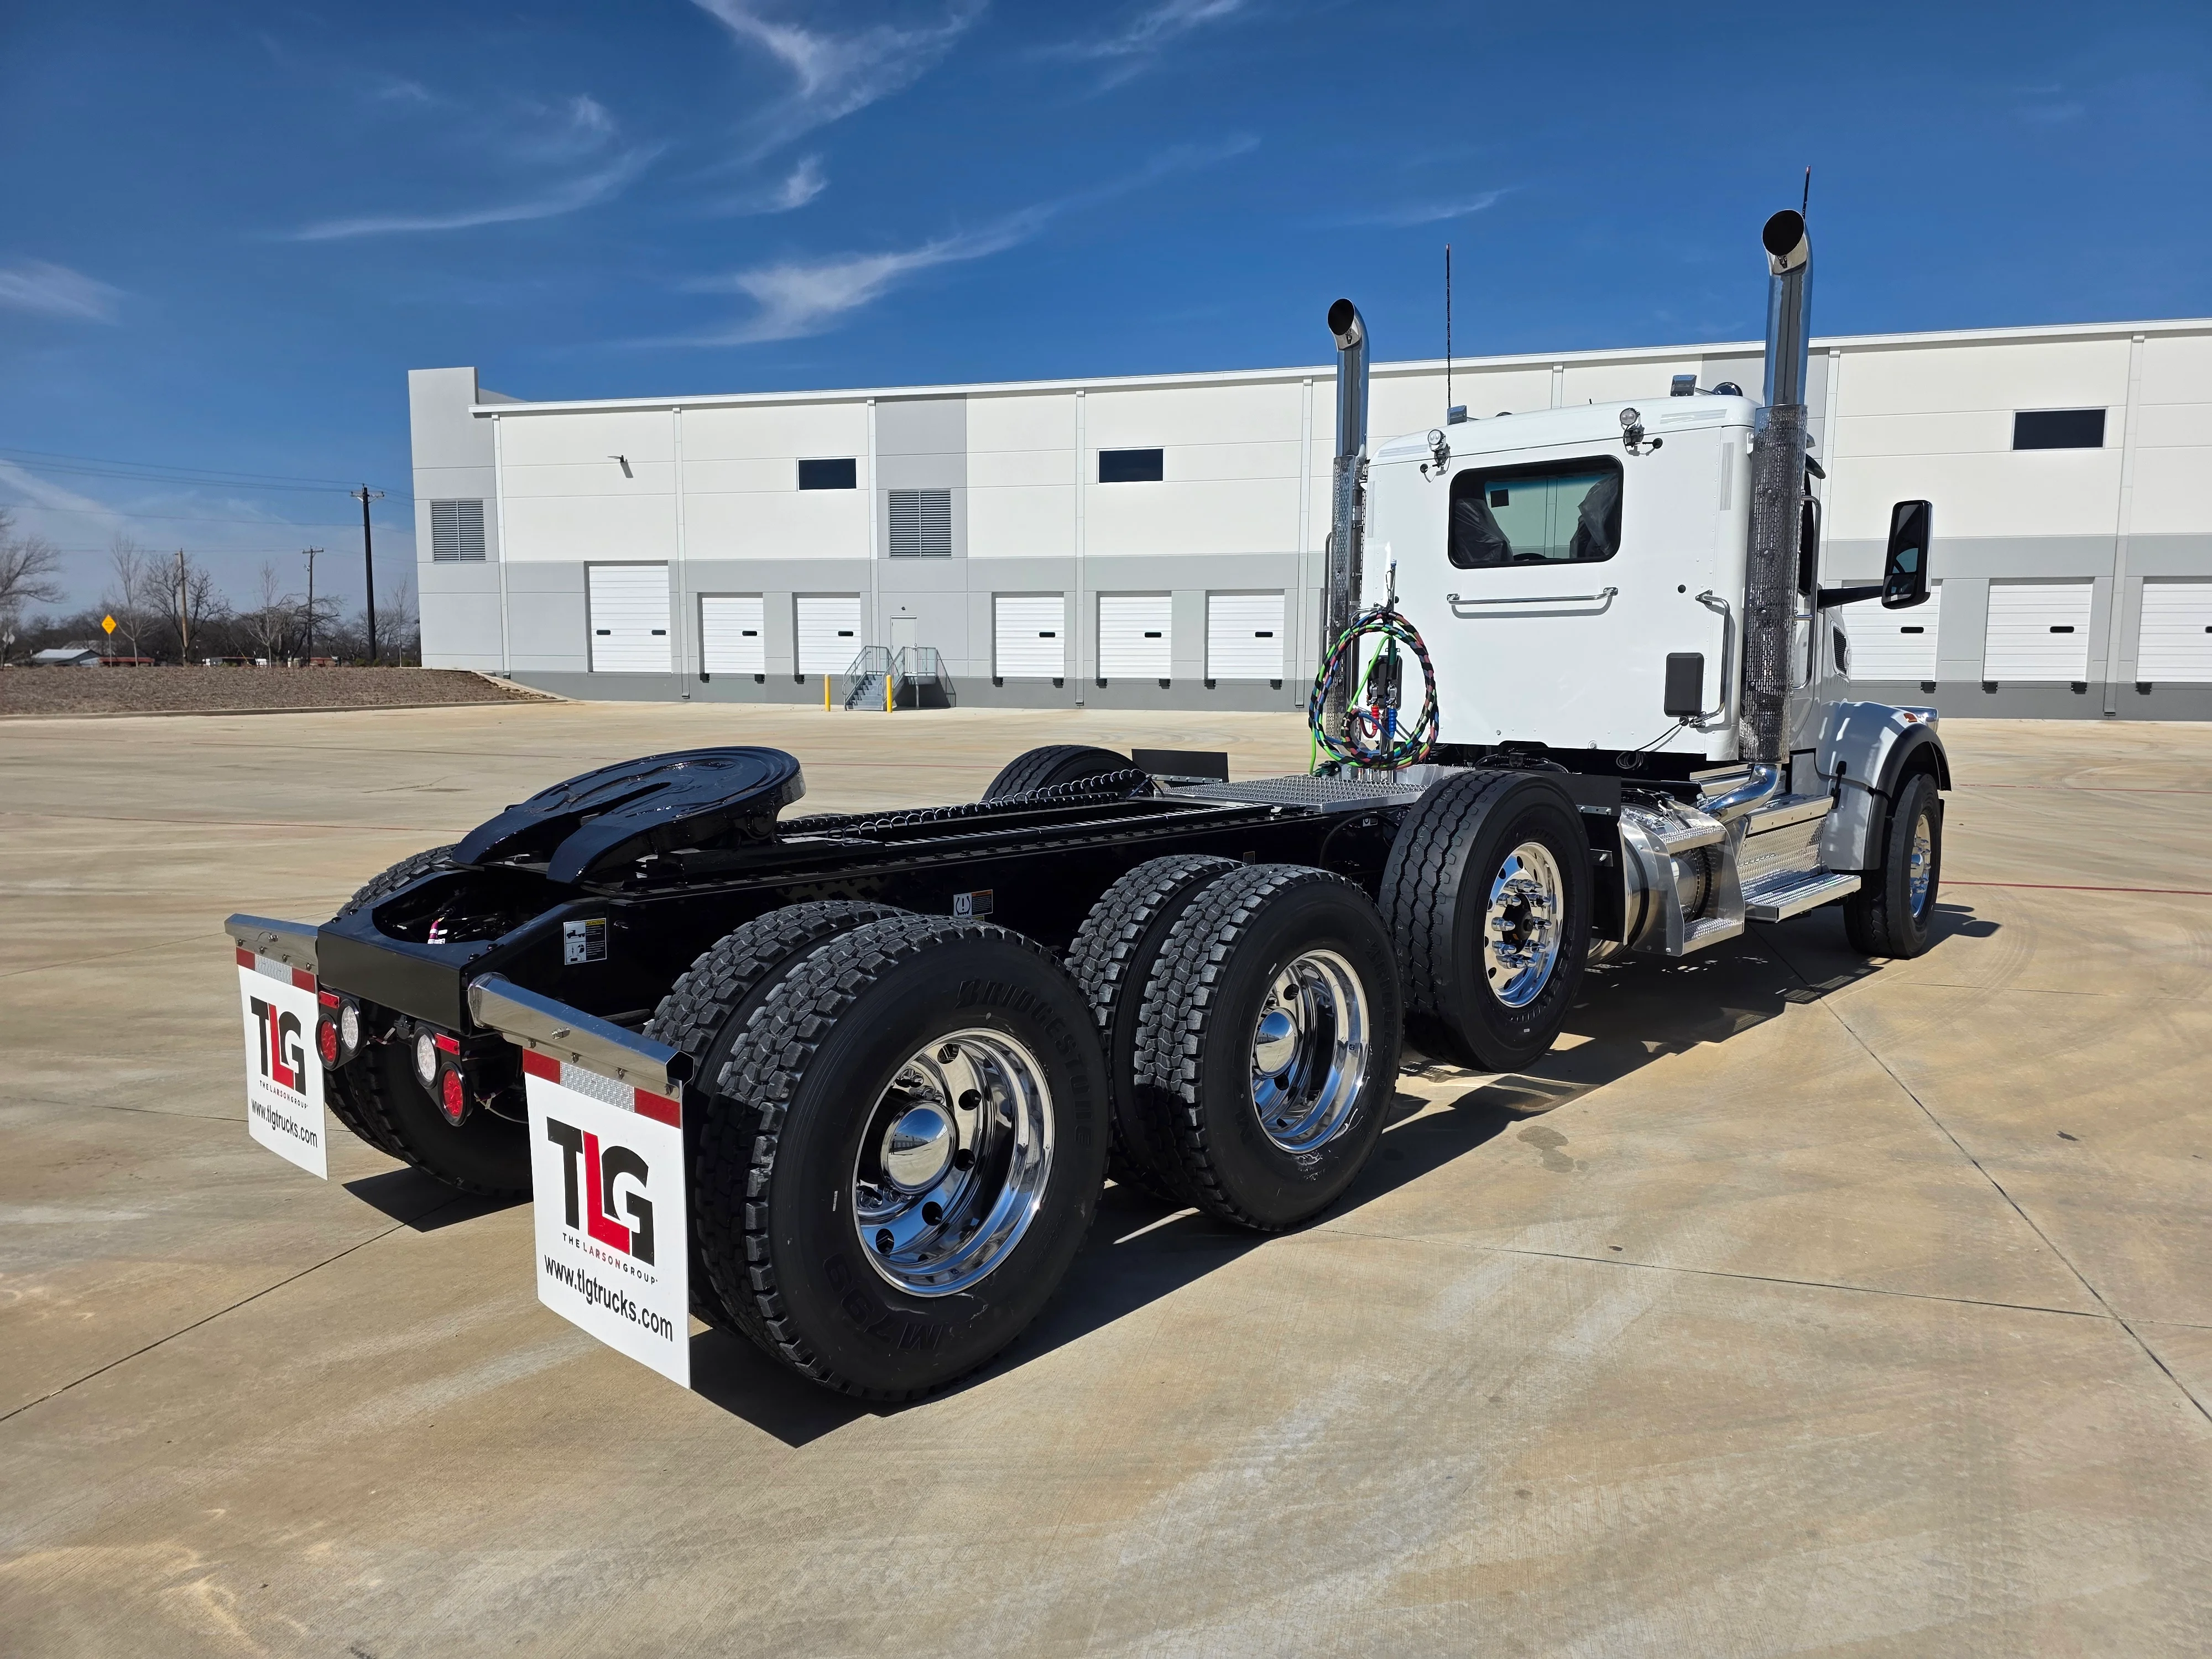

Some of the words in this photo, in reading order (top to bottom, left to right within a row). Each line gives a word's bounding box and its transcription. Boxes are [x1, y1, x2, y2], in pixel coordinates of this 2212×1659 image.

[250, 995, 306, 1096] TLG
[953, 979, 1092, 1146] BRIDGESTONE
[251, 1097, 318, 1148] www.tlgtrucks.com
[259, 1080, 269, 1091] THE
[270, 1085, 290, 1101] LARSON
[291, 1096, 307, 1110] GROUP
[546, 1116, 655, 1267] TLG
[544, 1254, 673, 1342] www.tlgtrucks.com
[562, 1232, 580, 1249] THE
[583, 1242, 620, 1269] LARSON
[623, 1263, 656, 1285] GROUP
[823, 1253, 949, 1351] M799
